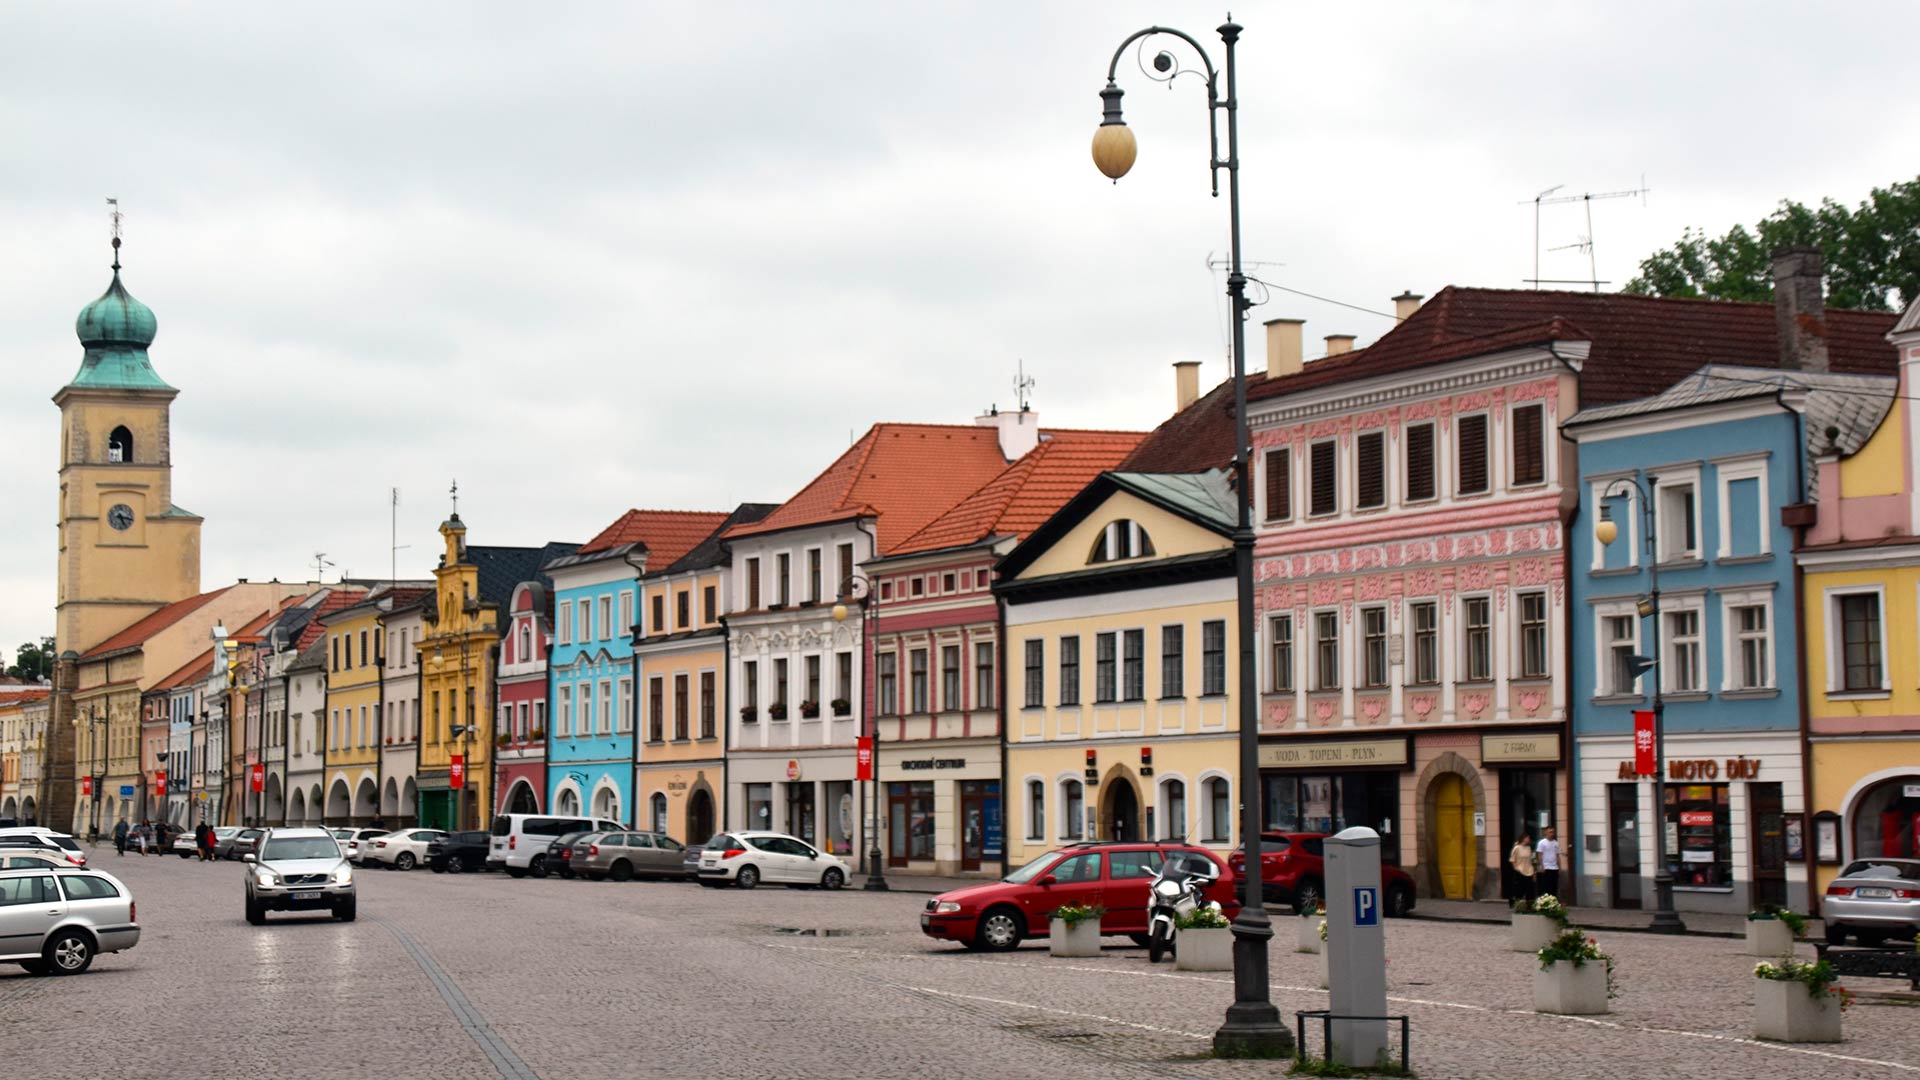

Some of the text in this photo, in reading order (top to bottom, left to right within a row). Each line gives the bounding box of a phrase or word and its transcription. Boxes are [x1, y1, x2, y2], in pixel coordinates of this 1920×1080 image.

[1274, 750, 1301, 762] VODA
[1351, 747, 1376, 760] PLYN
[1503, 743, 1509, 753] Z
[936, 759, 965, 769] CENTRUM
[1669, 759, 1718, 780] MOTO
[1726, 755, 1761, 779] DÍLY
[1359, 890, 1372, 919] P
